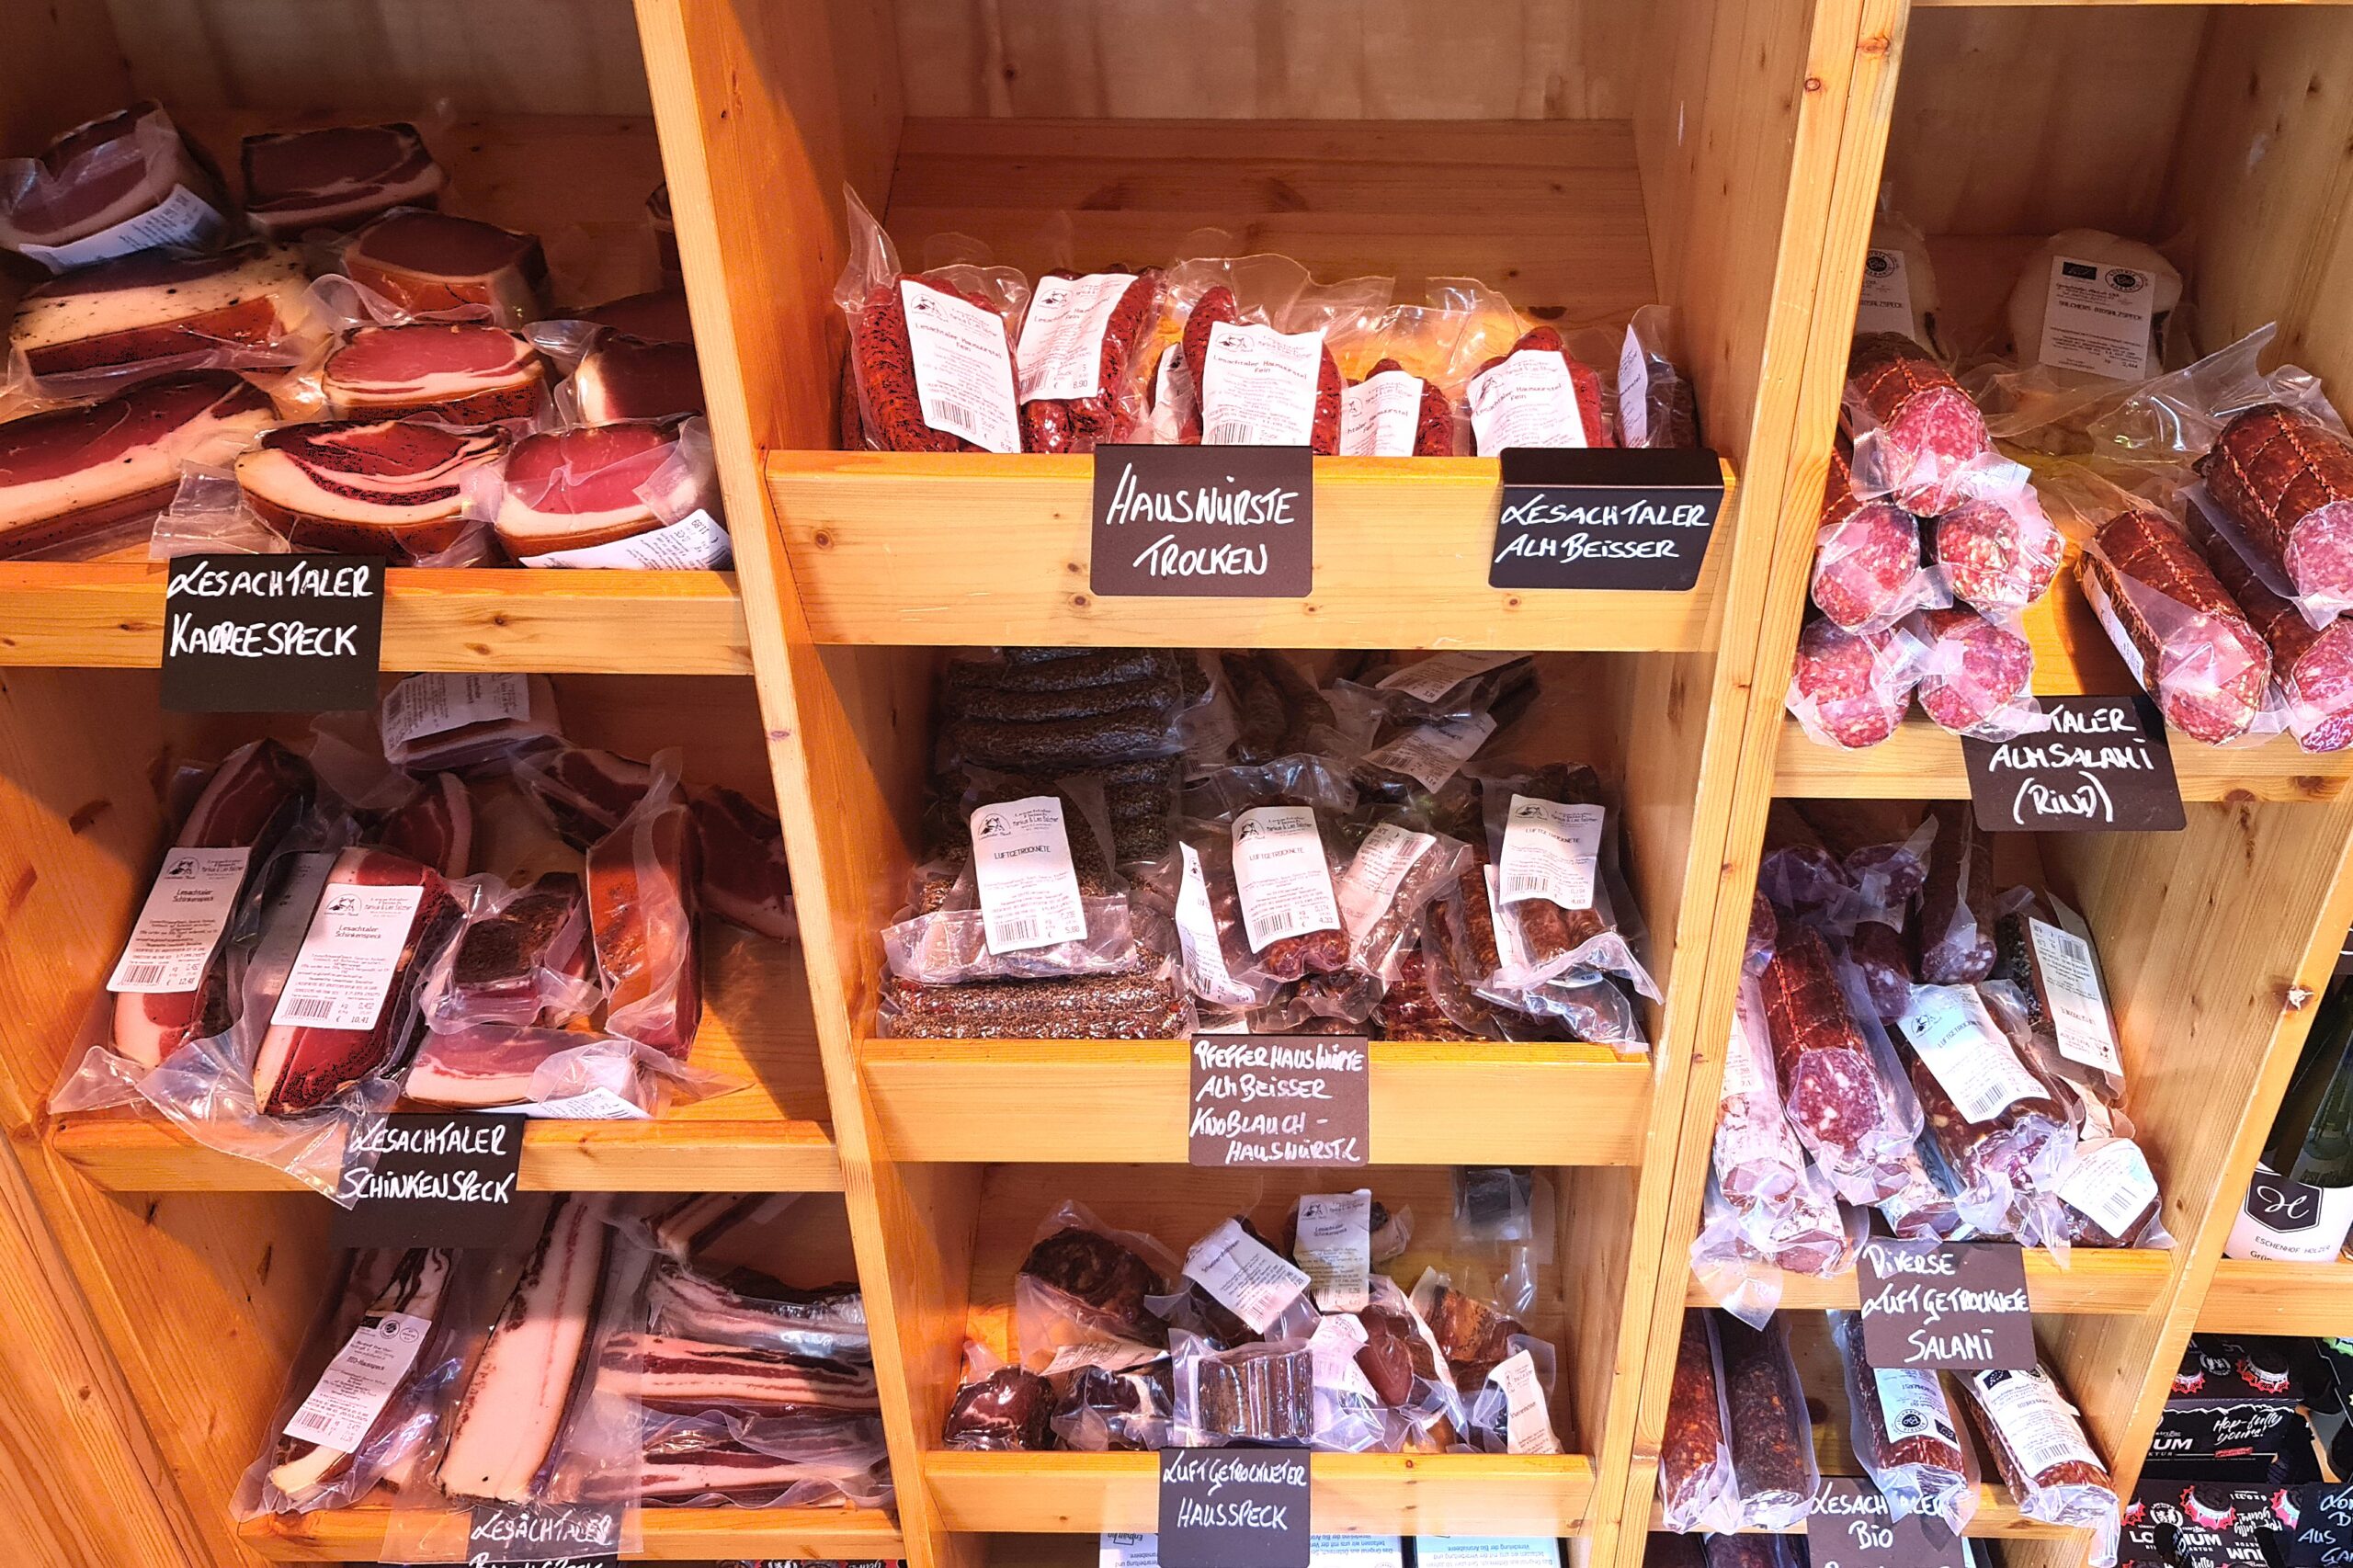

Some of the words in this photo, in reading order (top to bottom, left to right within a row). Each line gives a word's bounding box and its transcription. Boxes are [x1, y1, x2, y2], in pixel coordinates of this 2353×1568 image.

[1347, 421, 1368, 435] htaler
[1132, 534, 1268, 577] TROCKEN
[166, 560, 374, 599] LESACHTALER
[995, 845, 1051, 859] LUFTGETROCKNETE
[1249, 847, 1305, 861] LUFTGETROCKNETE
[176, 889, 213, 897] Lesachtaler
[335, 931, 381, 939] Schinkenspeck
[349, 1118, 506, 1155] LESACHTALER
[2255, 1235, 2300, 1254] ESCHENHOF
[2304, 1244, 2331, 1255] HOLZER
[2213, 1411, 2283, 1432] Hop-fully
[2153, 1438, 2193, 1450] UM
[2214, 1426, 2268, 1446] yours!
[1177, 1502, 1288, 1531] HAUSSPECK
[2298, 1528, 2336, 1544] AUS
